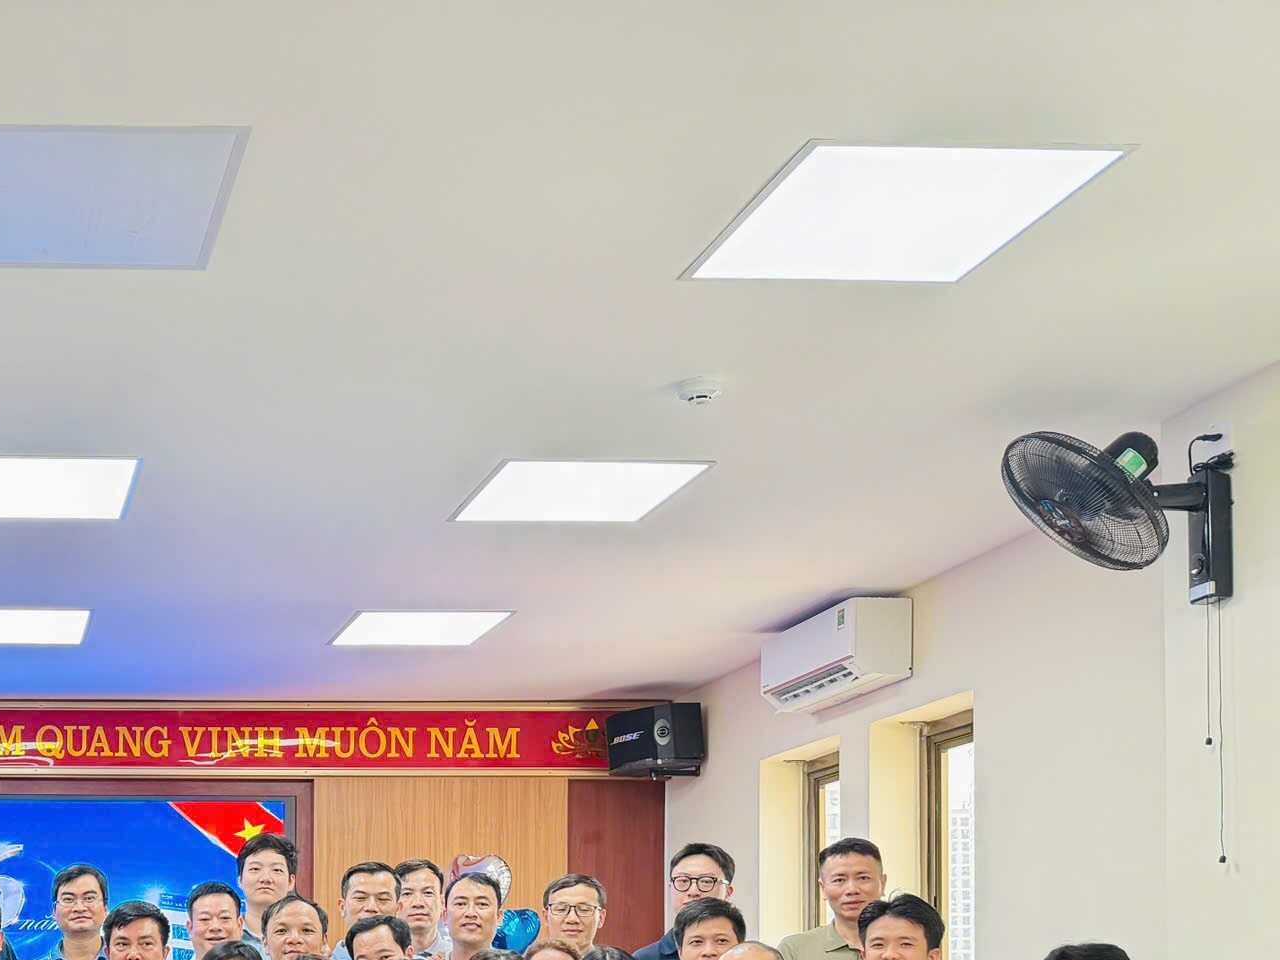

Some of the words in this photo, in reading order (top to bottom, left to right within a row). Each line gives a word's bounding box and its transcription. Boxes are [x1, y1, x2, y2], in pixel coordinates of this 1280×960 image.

[35, 724, 172, 759] QUANG
[178, 726, 285, 758] VINH
[295, 717, 417, 758] MUÔN
[426, 718, 521, 759] NĂM
[610, 730, 645, 746] BOSE
